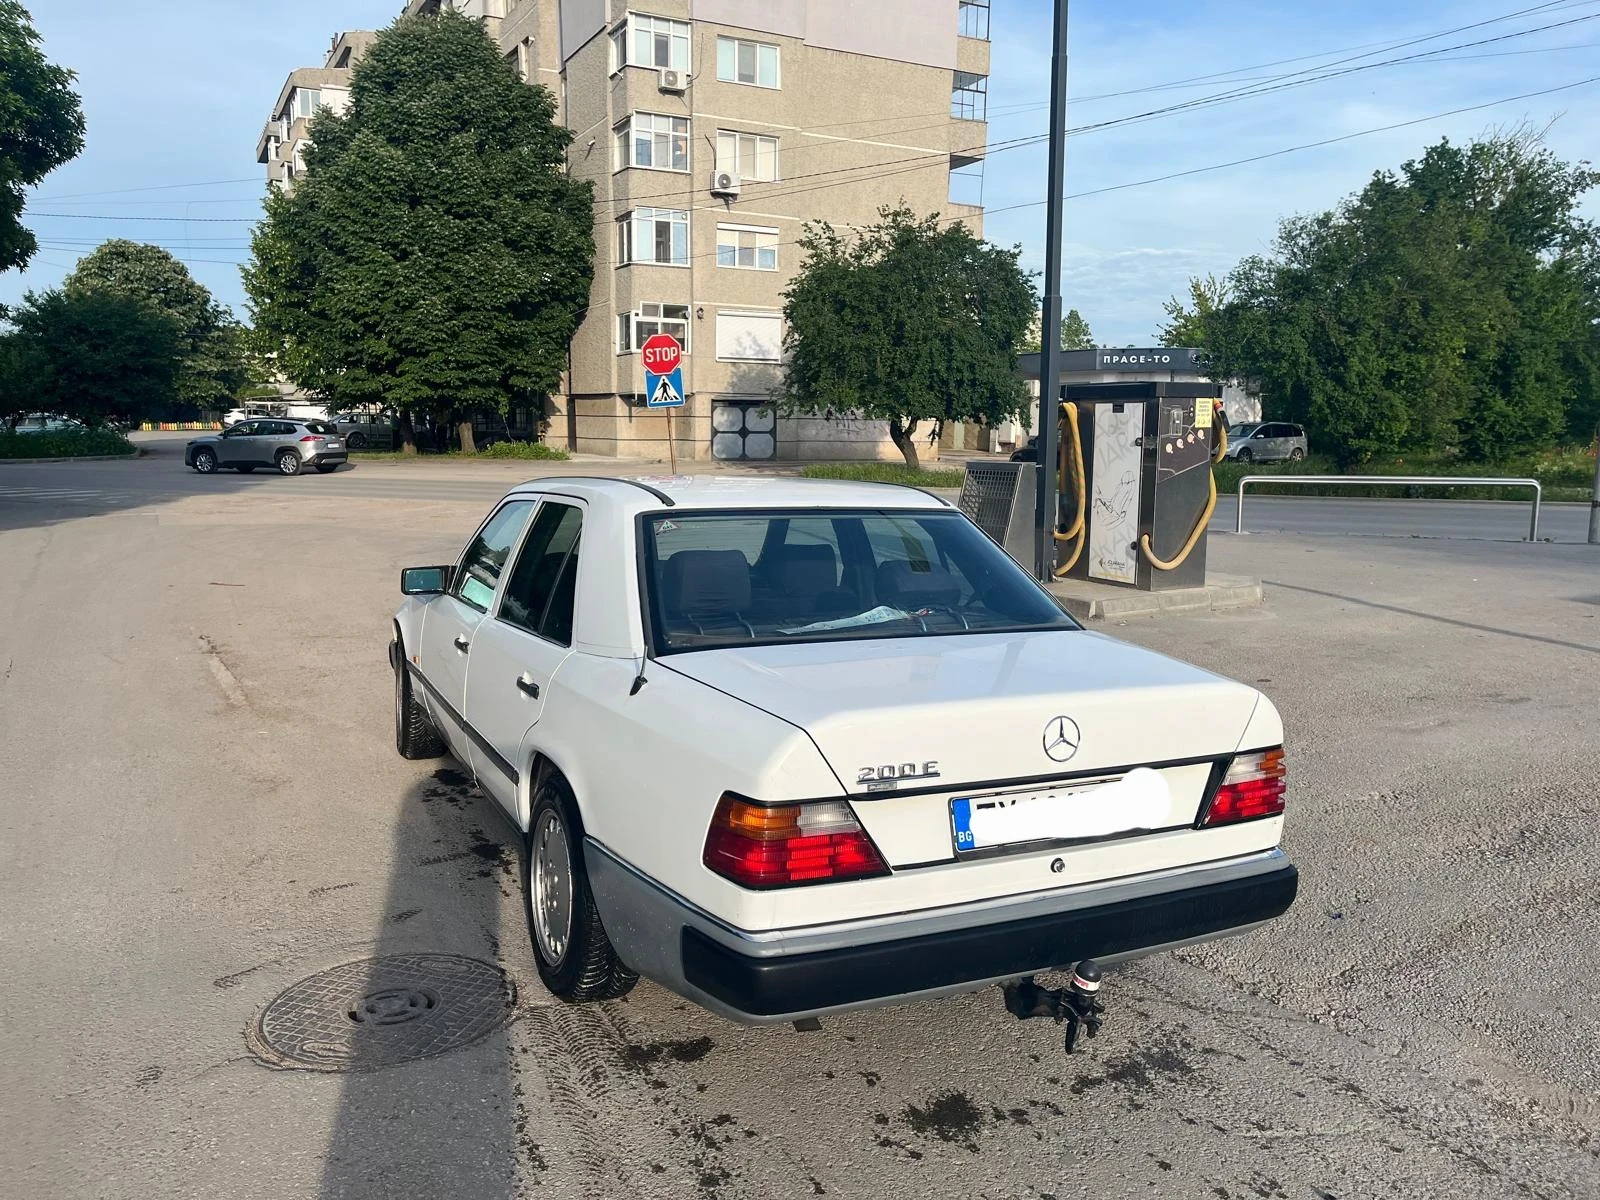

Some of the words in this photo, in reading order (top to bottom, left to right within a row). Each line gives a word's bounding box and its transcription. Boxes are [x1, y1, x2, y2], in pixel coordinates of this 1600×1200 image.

[645, 347, 677, 362] STOP
[1103, 355, 1171, 364] ПРАСЕ-ТО
[857, 762, 916, 781] 200
[922, 760, 939, 775] E
[958, 830, 973, 843] BG
